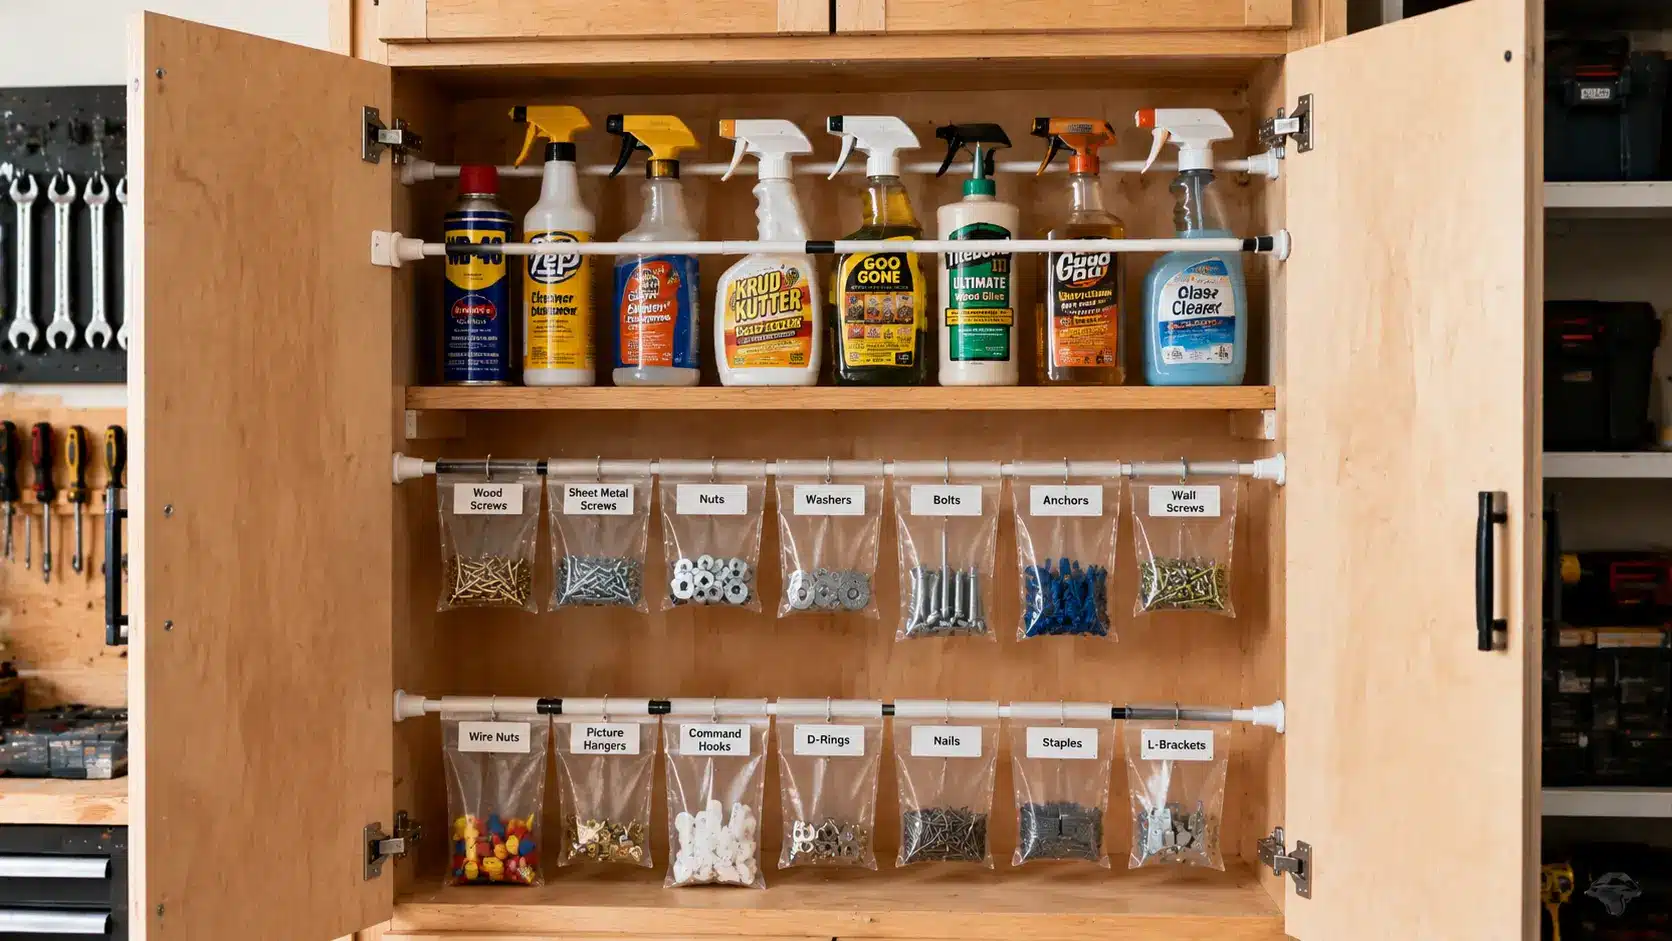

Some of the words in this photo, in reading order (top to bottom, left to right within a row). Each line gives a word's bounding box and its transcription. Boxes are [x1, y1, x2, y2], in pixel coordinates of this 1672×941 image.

[863, 256, 901, 270] GOO
[857, 271, 901, 283] GONE
[735, 270, 781, 299] KRUD
[953, 277, 1006, 289] ULTIMATE
[735, 289, 802, 322] KUTTER
[473, 488, 502, 497] Wood
[569, 488, 597, 497] Sheet
[601, 488, 628, 497] Metal
[1172, 491, 1195, 500] Wall
[700, 495, 724, 503] Nuts
[806, 495, 851, 504] Washers
[934, 495, 960, 504] Bolts
[1043, 495, 1089, 505] Anchors
[471, 501, 507, 510] Screws
[581, 501, 616, 510] Screws
[1167, 504, 1204, 512] Screws
[469, 732, 493, 741] Wire
[496, 733, 519, 742] Nuts
[587, 728, 624, 737] Picture
[689, 728, 741, 738] Command
[808, 735, 849, 747] D-Rings
[934, 736, 960, 745] Nails
[1043, 738, 1082, 750] Staples
[1148, 740, 1206, 749] L-Brackets
[584, 741, 626, 752] Hangers
[699, 742, 731, 751] Hooks
